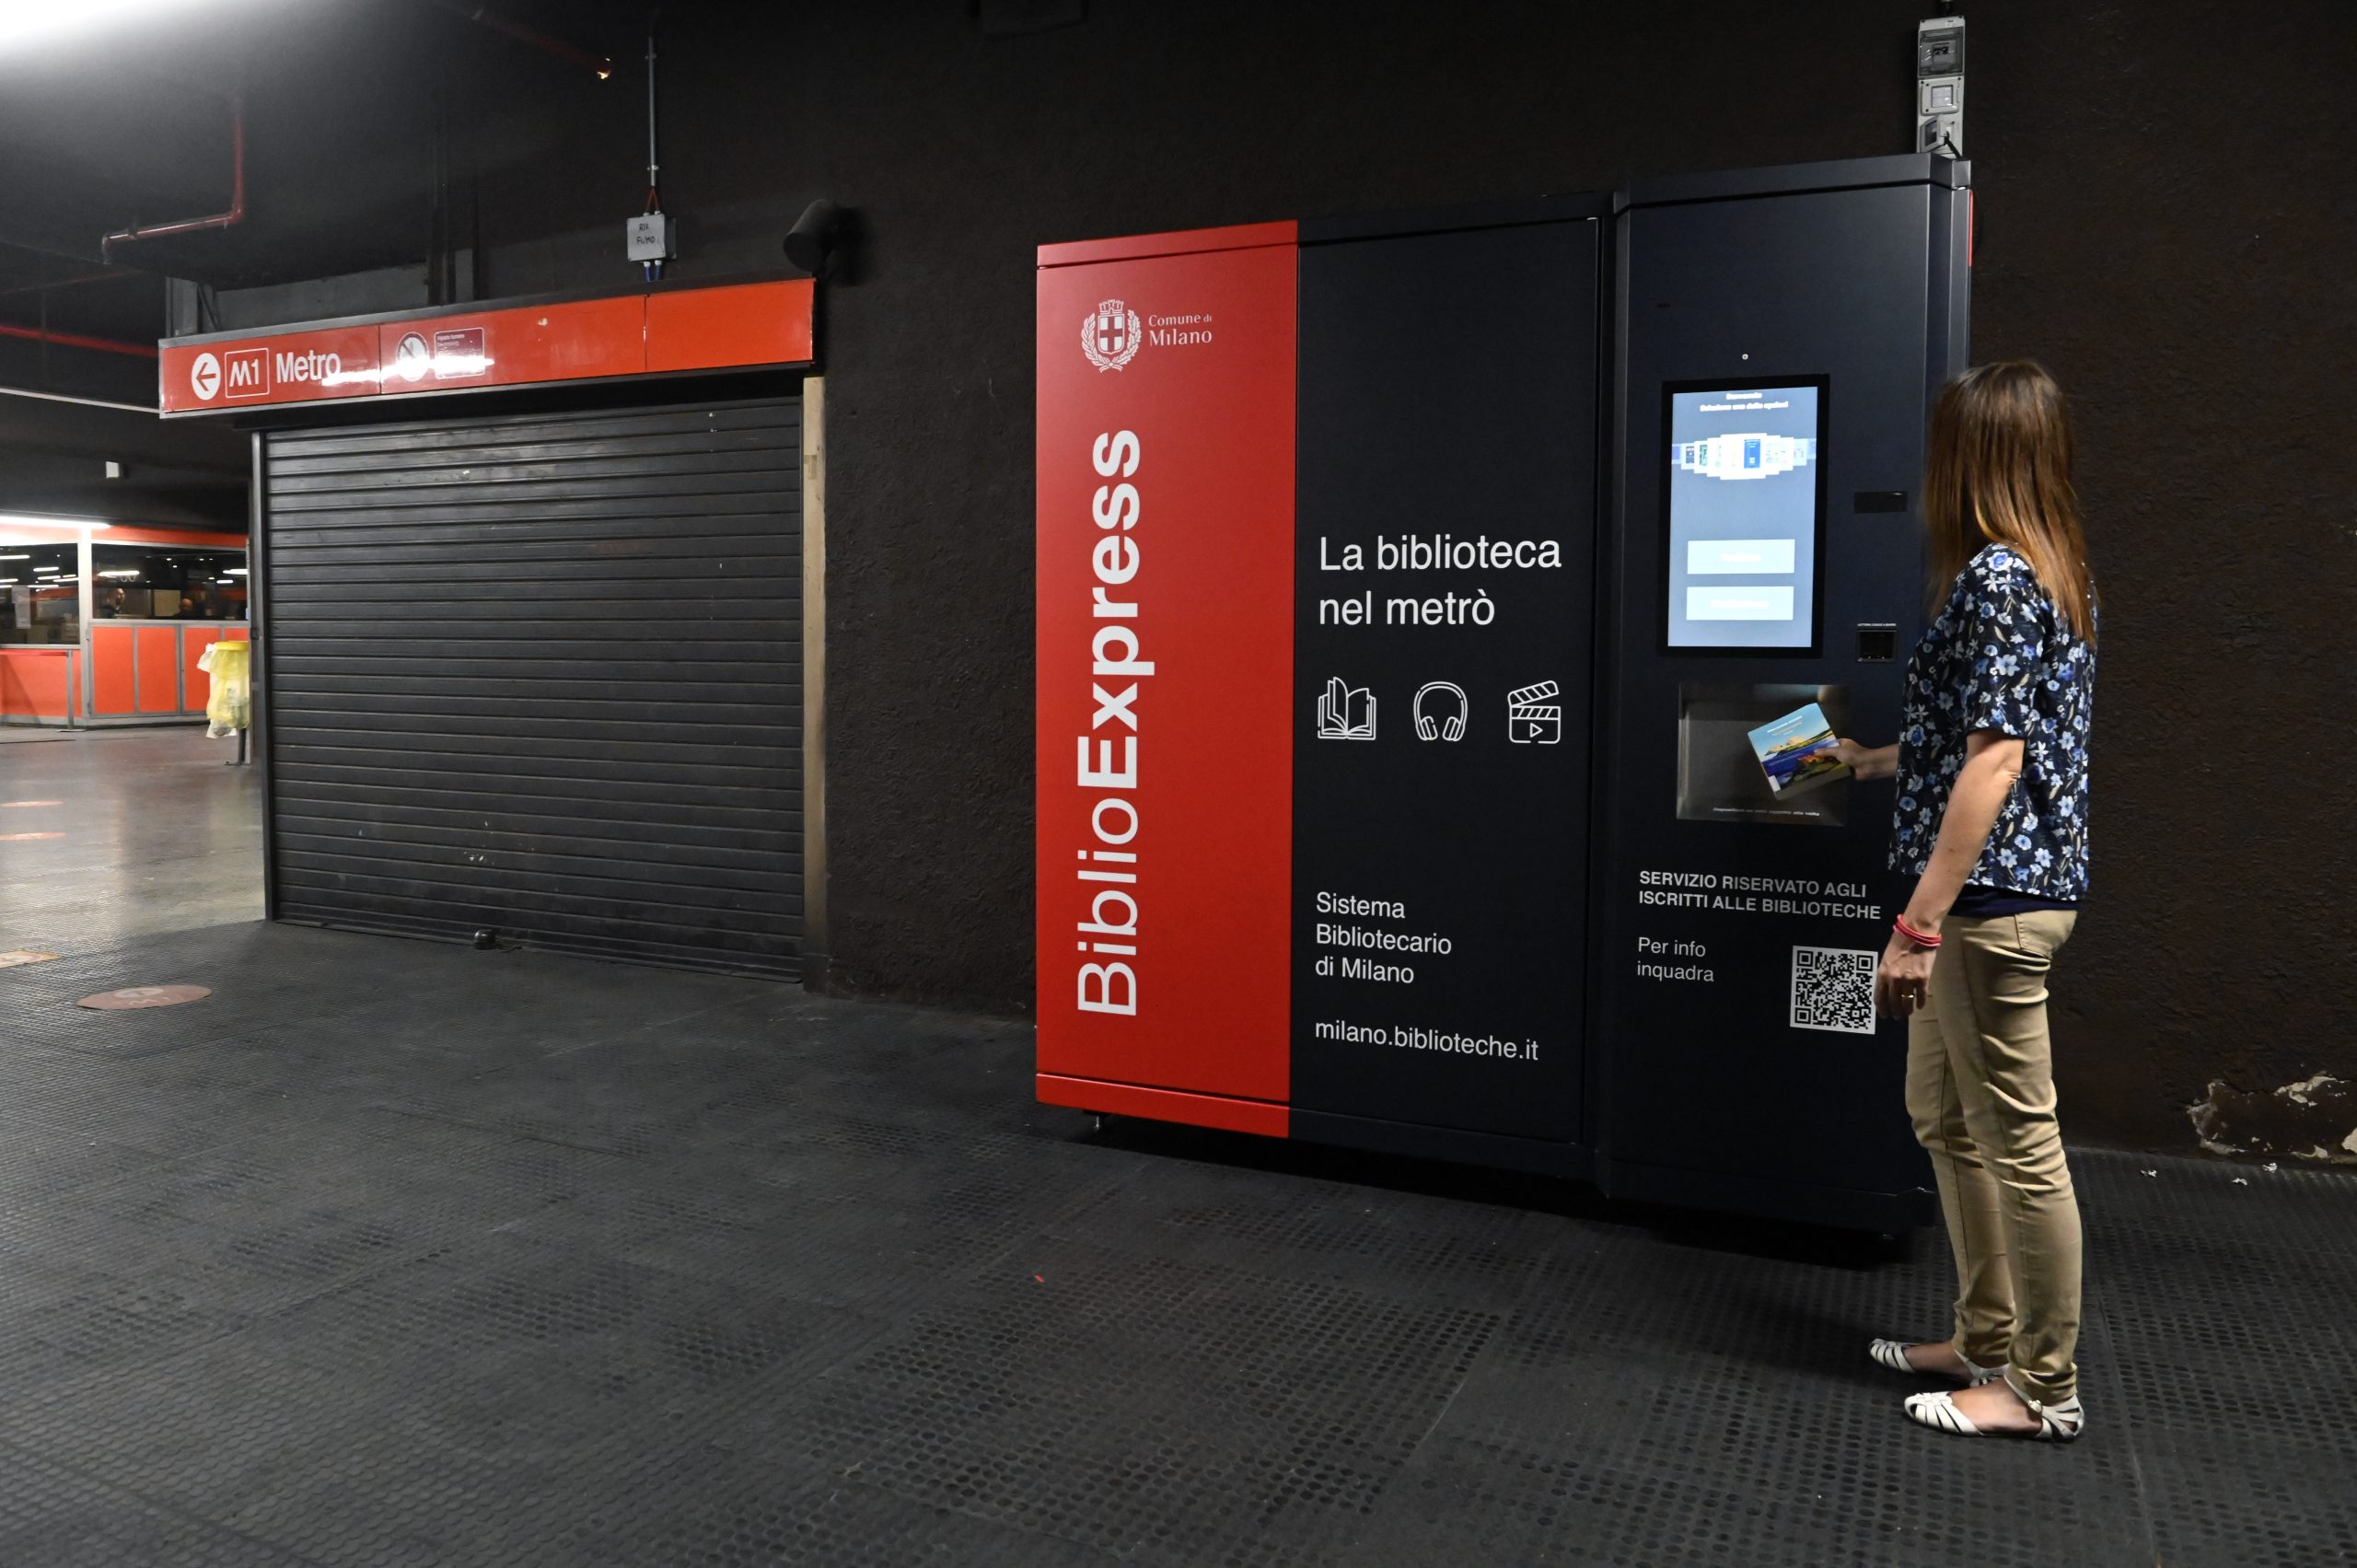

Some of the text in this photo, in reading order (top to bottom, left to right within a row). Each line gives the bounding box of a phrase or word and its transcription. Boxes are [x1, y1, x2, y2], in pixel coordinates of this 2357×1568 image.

[1148, 314, 1213, 327] Comune di
[1149, 329, 1213, 346] Milano
[229, 350, 341, 388] M1 Metro
[1320, 533, 1562, 571] La biblioteca
[1319, 588, 1495, 625] nel metrò
[1077, 429, 1155, 1016] BiblioExpress
[1639, 870, 1866, 899] SERVIZIO RISERVATO AGLI
[1316, 891, 1406, 919] Sistema
[1639, 890, 1882, 920] ISCRITTI ALLE BIBLIOTECHE
[1316, 923, 1452, 955] Bibliotecario
[1638, 936, 1706, 958] Per info
[1315, 956, 1415, 984] di Milano
[1637, 960, 1715, 982] inquadra
[1315, 1019, 1539, 1061] milano.biblioteche.it
